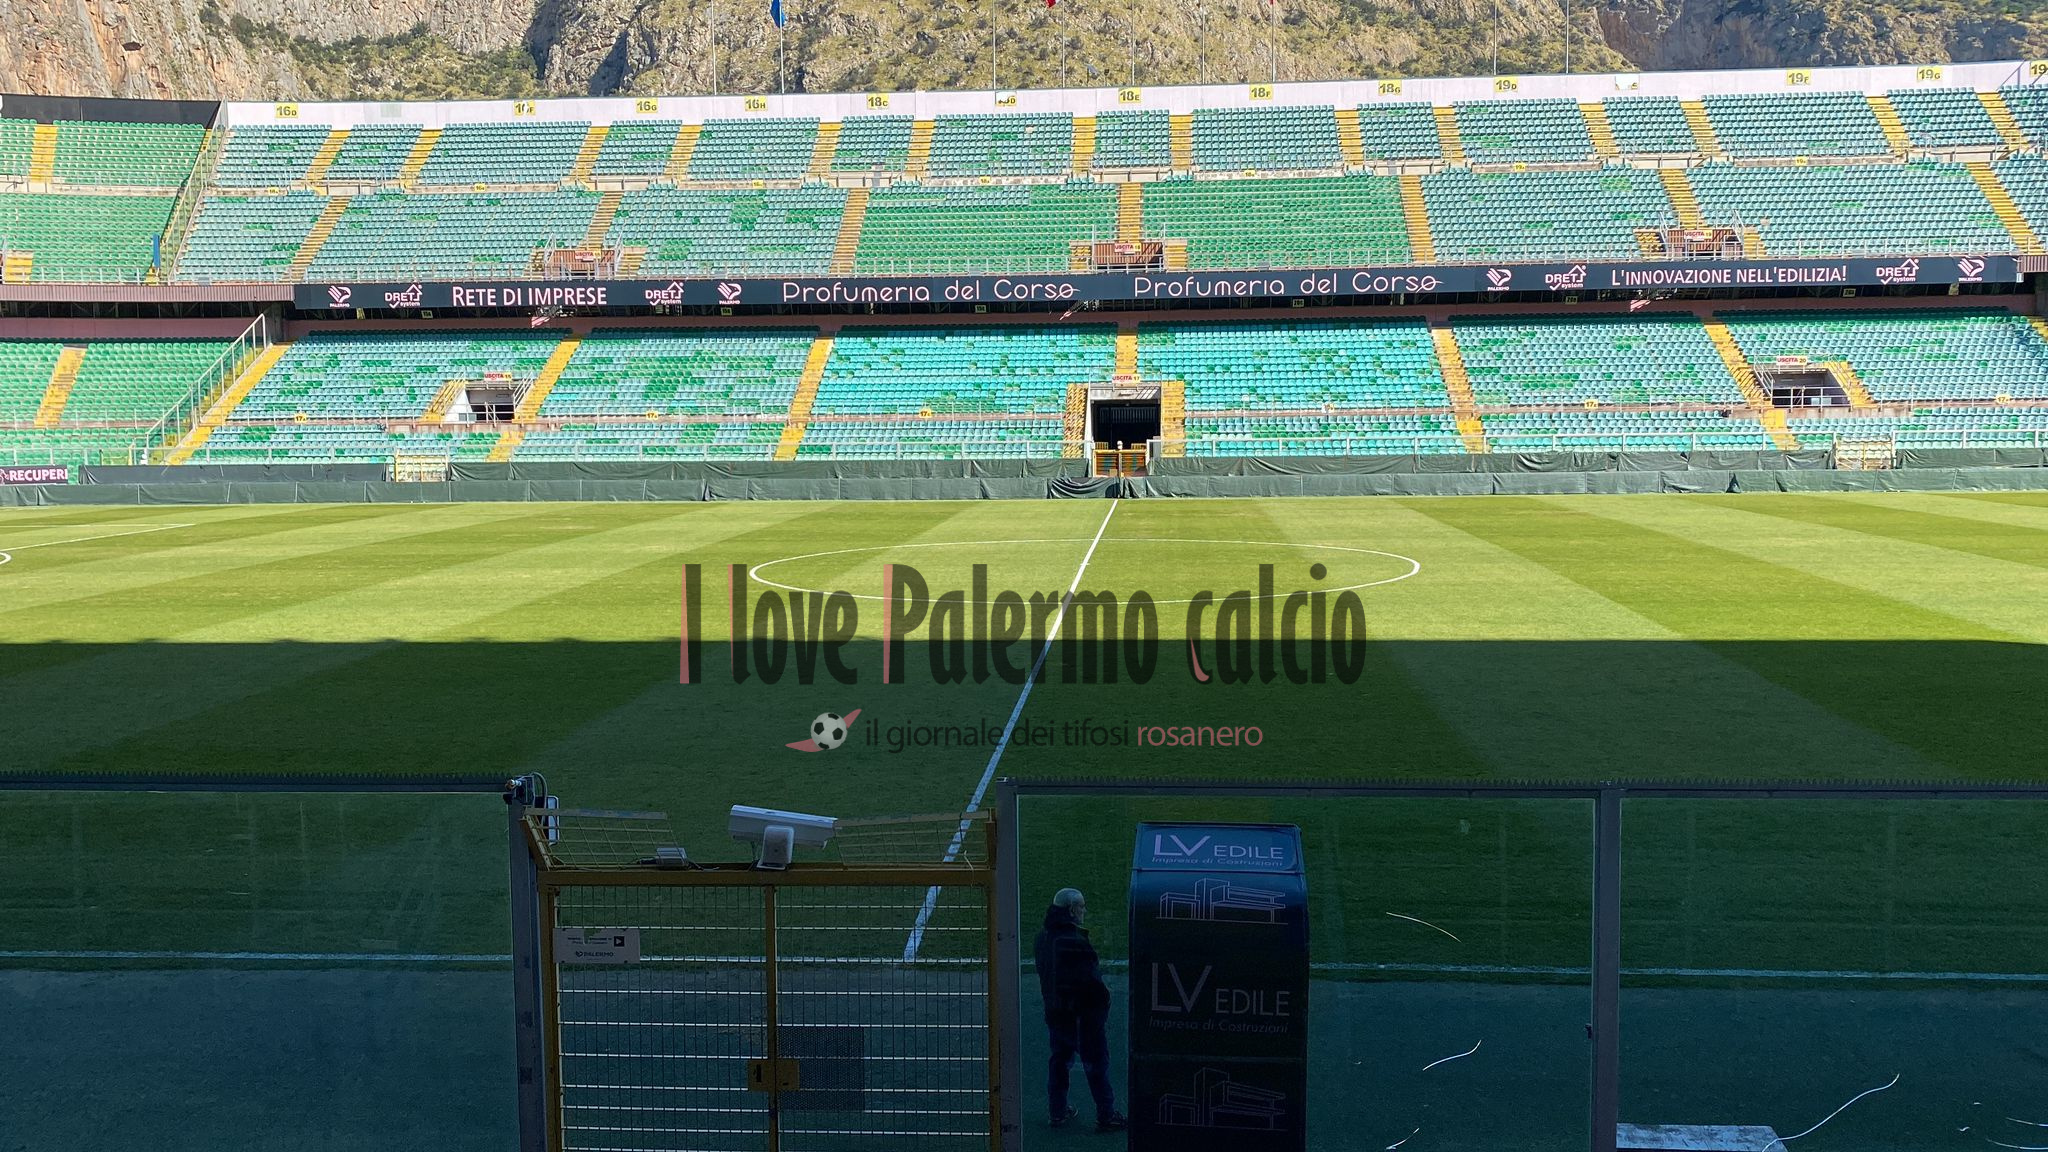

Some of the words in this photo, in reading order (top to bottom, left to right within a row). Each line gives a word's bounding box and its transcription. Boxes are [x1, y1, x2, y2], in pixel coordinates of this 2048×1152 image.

[1379, 82, 1400, 94] 18G
[1495, 80, 1516, 90] 19D
[1120, 91, 1140, 102] 18E
[1251, 88, 1270, 98] 18F
[636, 101, 657, 111] 16G
[869, 97, 888, 107] 18C
[276, 106, 297, 116] 16D
[1611, 268, 1732, 287] L'INNOVAZIONE
[1736, 265, 1847, 284] NELL'EDILIZIA!
[1893, 276, 1916, 284] system
[1134, 276, 1284, 298] Profumeria
[1300, 273, 1336, 294] del
[1352, 271, 1440, 293] Corso
[1561, 282, 1583, 290] system
[783, 281, 929, 302] Profumeria
[945, 279, 979, 301] del
[994, 279, 1078, 301] Corso
[503, 288, 521, 306] DI
[528, 287, 607, 306] IMPRESE
[660, 298, 682, 306] system
[1153, 834, 1212, 857] LV
[1214, 845, 1285, 860] EDILE
[1151, 857, 1199, 865] Impresa
[1202, 857, 1214, 865] di
[1151, 962, 1213, 1013] LV
[1215, 988, 1290, 1016] EDILE
[1149, 1017, 1199, 1031] Impresa
[1202, 1019, 1215, 1031] di
[1218, 1020, 1289, 1034] Costruzioni
